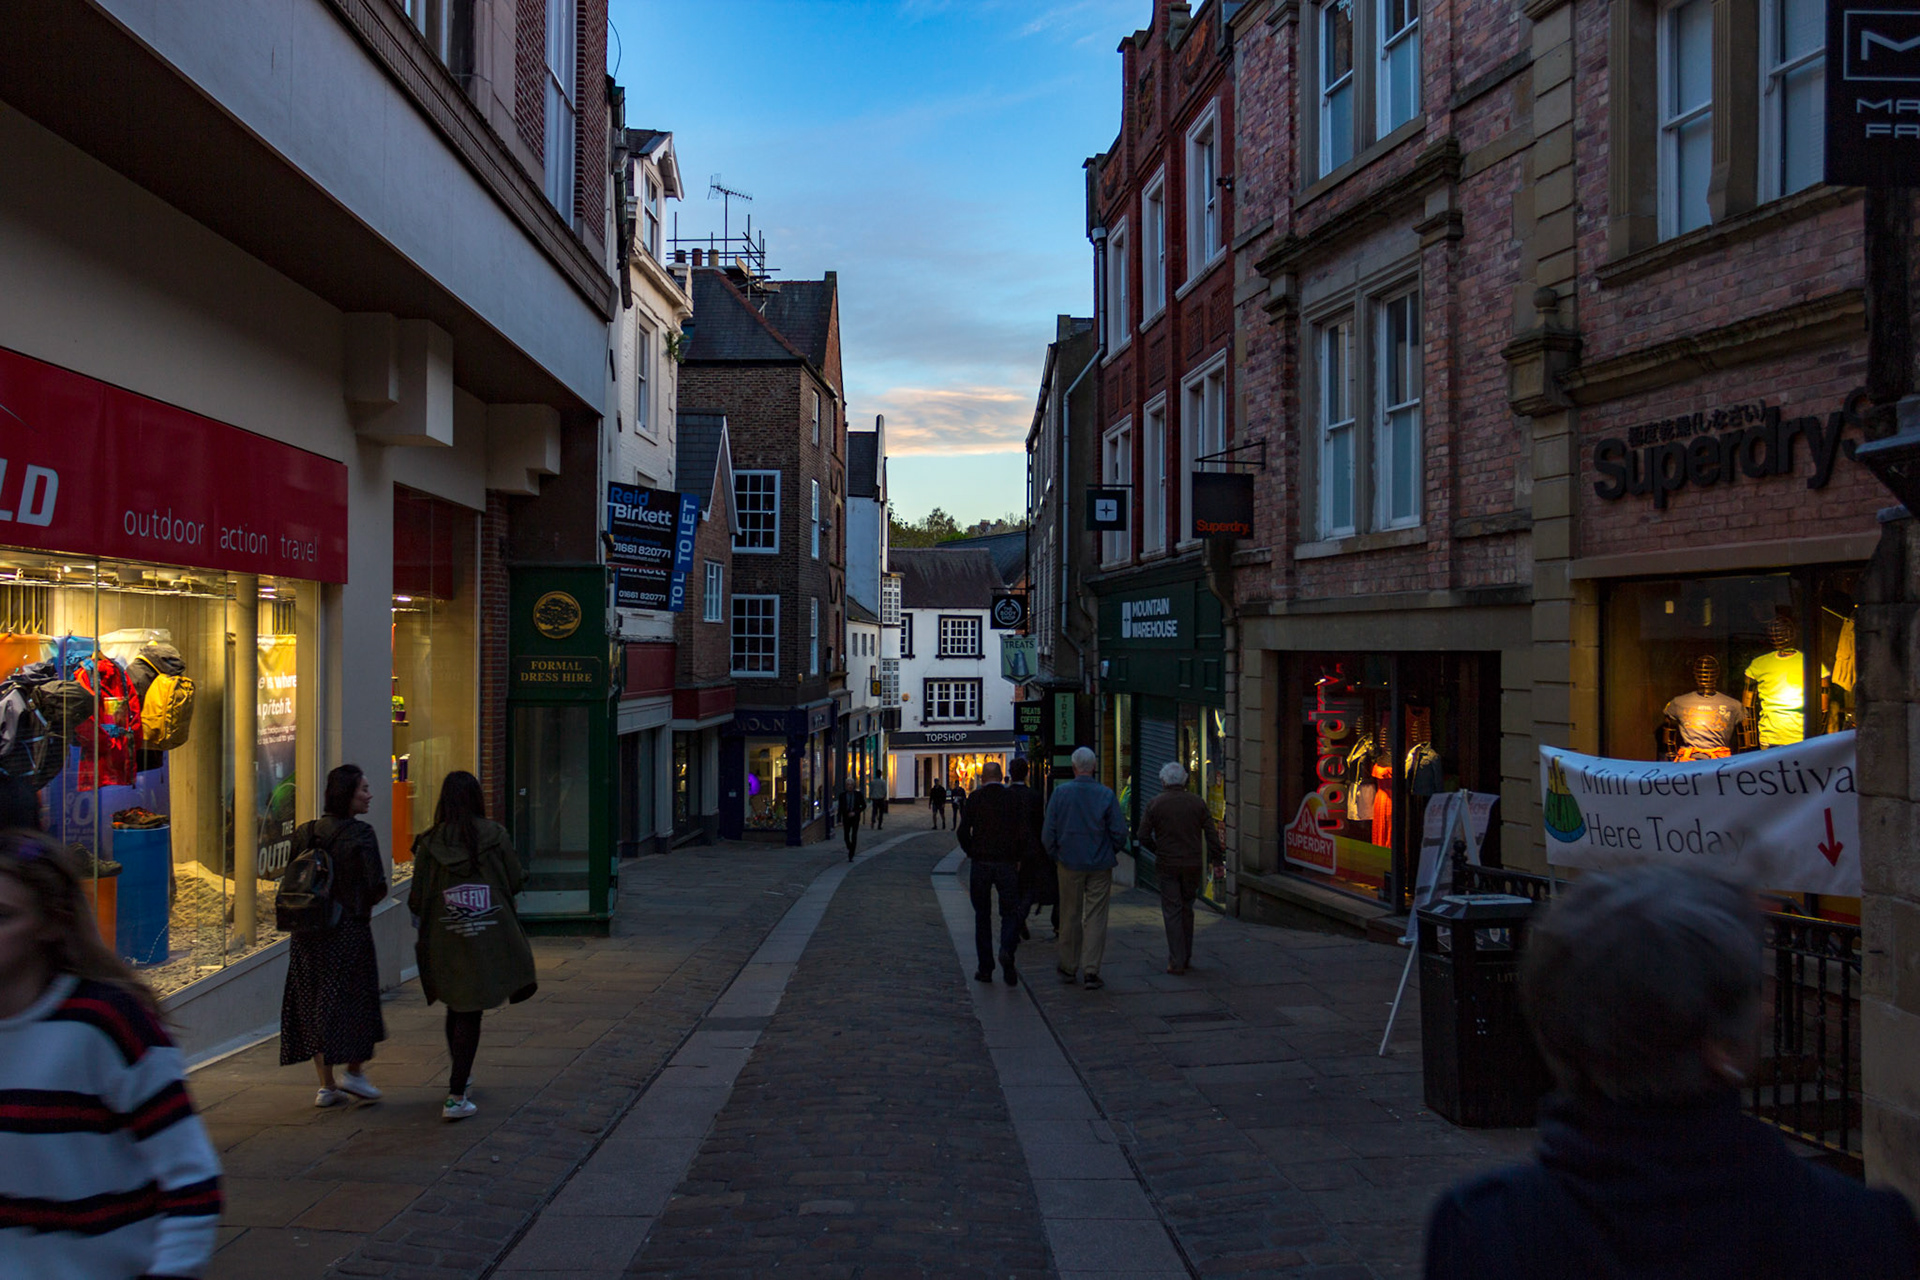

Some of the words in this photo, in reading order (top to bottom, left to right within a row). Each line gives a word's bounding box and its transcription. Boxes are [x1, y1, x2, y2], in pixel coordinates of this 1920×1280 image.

[1865, 123, 1920, 139] FA
[1593, 406, 1844, 509] Superdry
[610, 486, 649, 506] Reid
[615, 504, 672, 526] Birkett
[681, 499, 697, 536] LET
[124, 507, 204, 545] outdoor
[219, 522, 268, 555] action
[280, 533, 318, 563] travel
[638, 546, 671, 558] 820771
[677, 539, 693, 564] TO
[671, 587, 684, 607] TO
[1132, 597, 1170, 618] MOUNTAIN
[1132, 619, 1178, 639] WAREHOUSE
[1004, 640, 1034, 650] TREATS
[530, 660, 582, 671] FORMAL
[520, 672, 559, 682] DRESS
[561, 672, 593, 683] HIRE
[262, 698, 285, 720] pitch
[925, 732, 967, 742] TOPSHOP
[1308, 663, 1353, 832] uperdry.
[1580, 765, 1634, 795] Mini
[1638, 768, 1702, 796] Beer
[281, 819, 294, 836] THE
[1287, 831, 1332, 856] SUPERDRY
[1586, 813, 1642, 850] Here
[1646, 816, 1747, 865] Today
